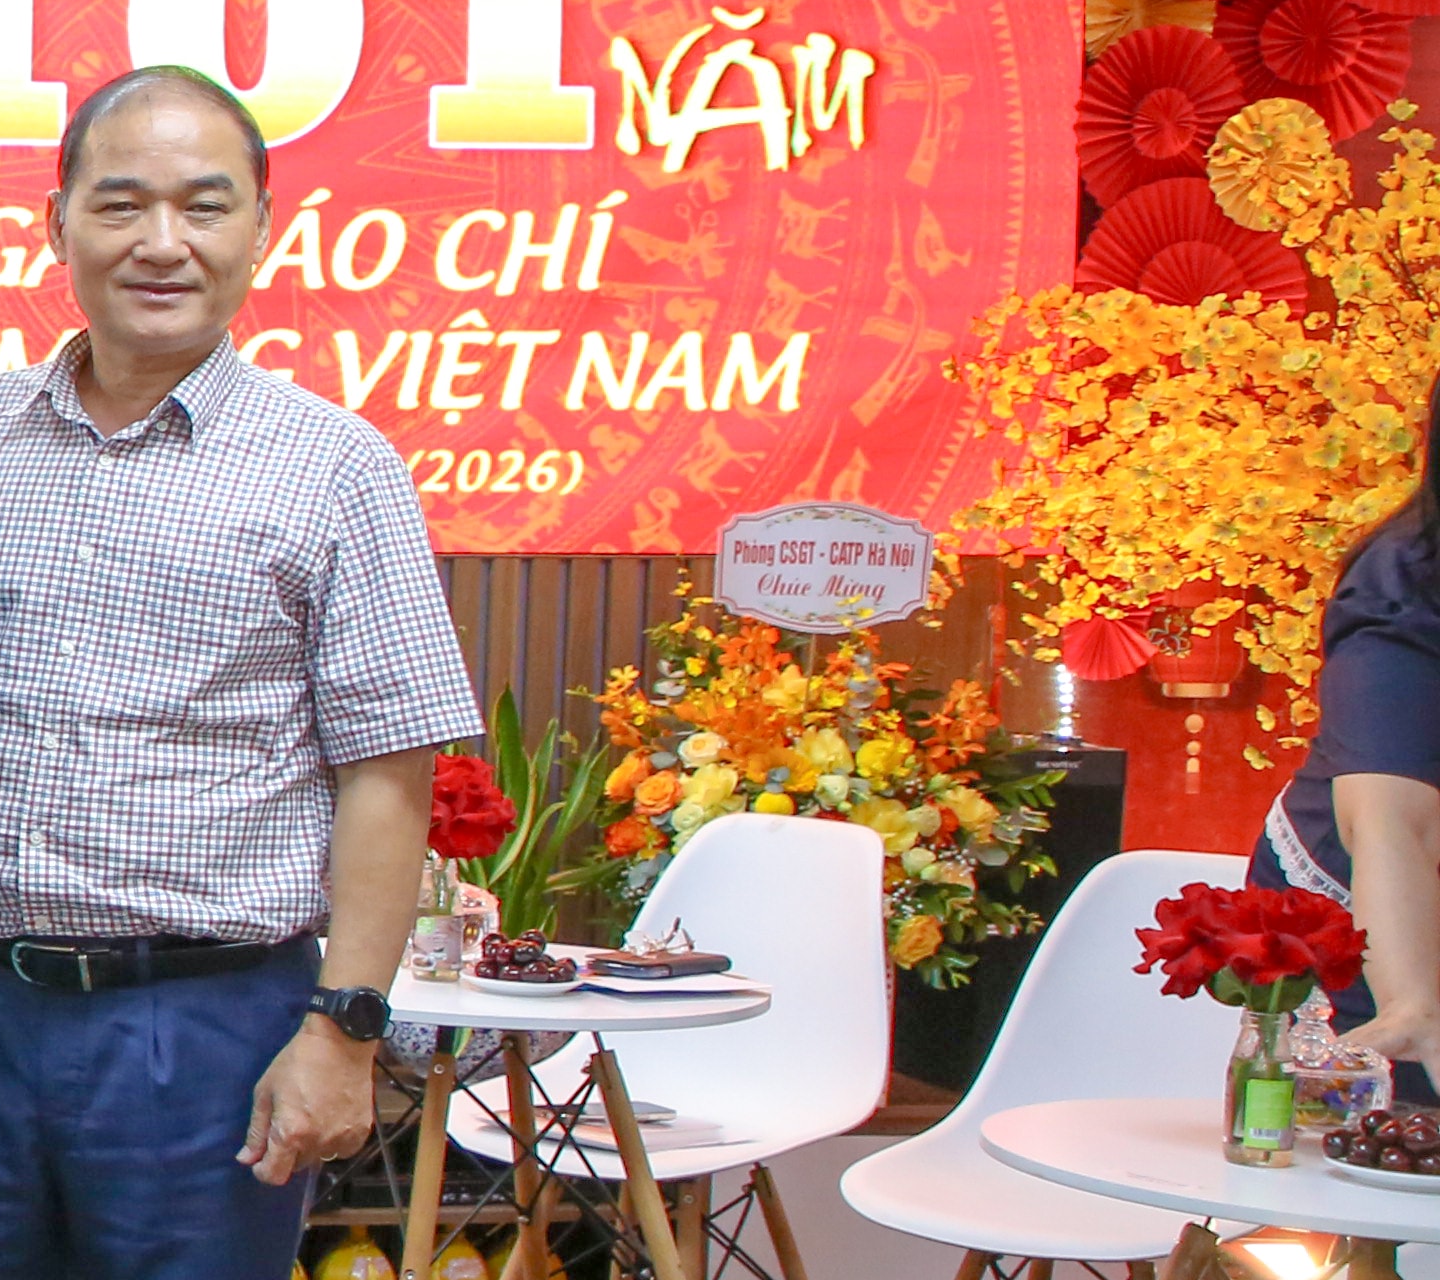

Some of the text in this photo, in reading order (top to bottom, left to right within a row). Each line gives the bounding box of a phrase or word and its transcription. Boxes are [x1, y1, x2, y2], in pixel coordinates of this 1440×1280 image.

[610, 6, 875, 172] NĂM
[251, 188, 408, 291] ÁO
[435, 190, 629, 297] CHÍ
[333, 309, 561, 425] VIỆT
[564, 330, 811, 412] NAM
[733, 539, 776, 567] Phòng
[779, 541, 816, 564] CSGT
[830, 541, 864, 565] CATP
[867, 540, 886, 566] Hà
[891, 542, 915, 572] Nội
